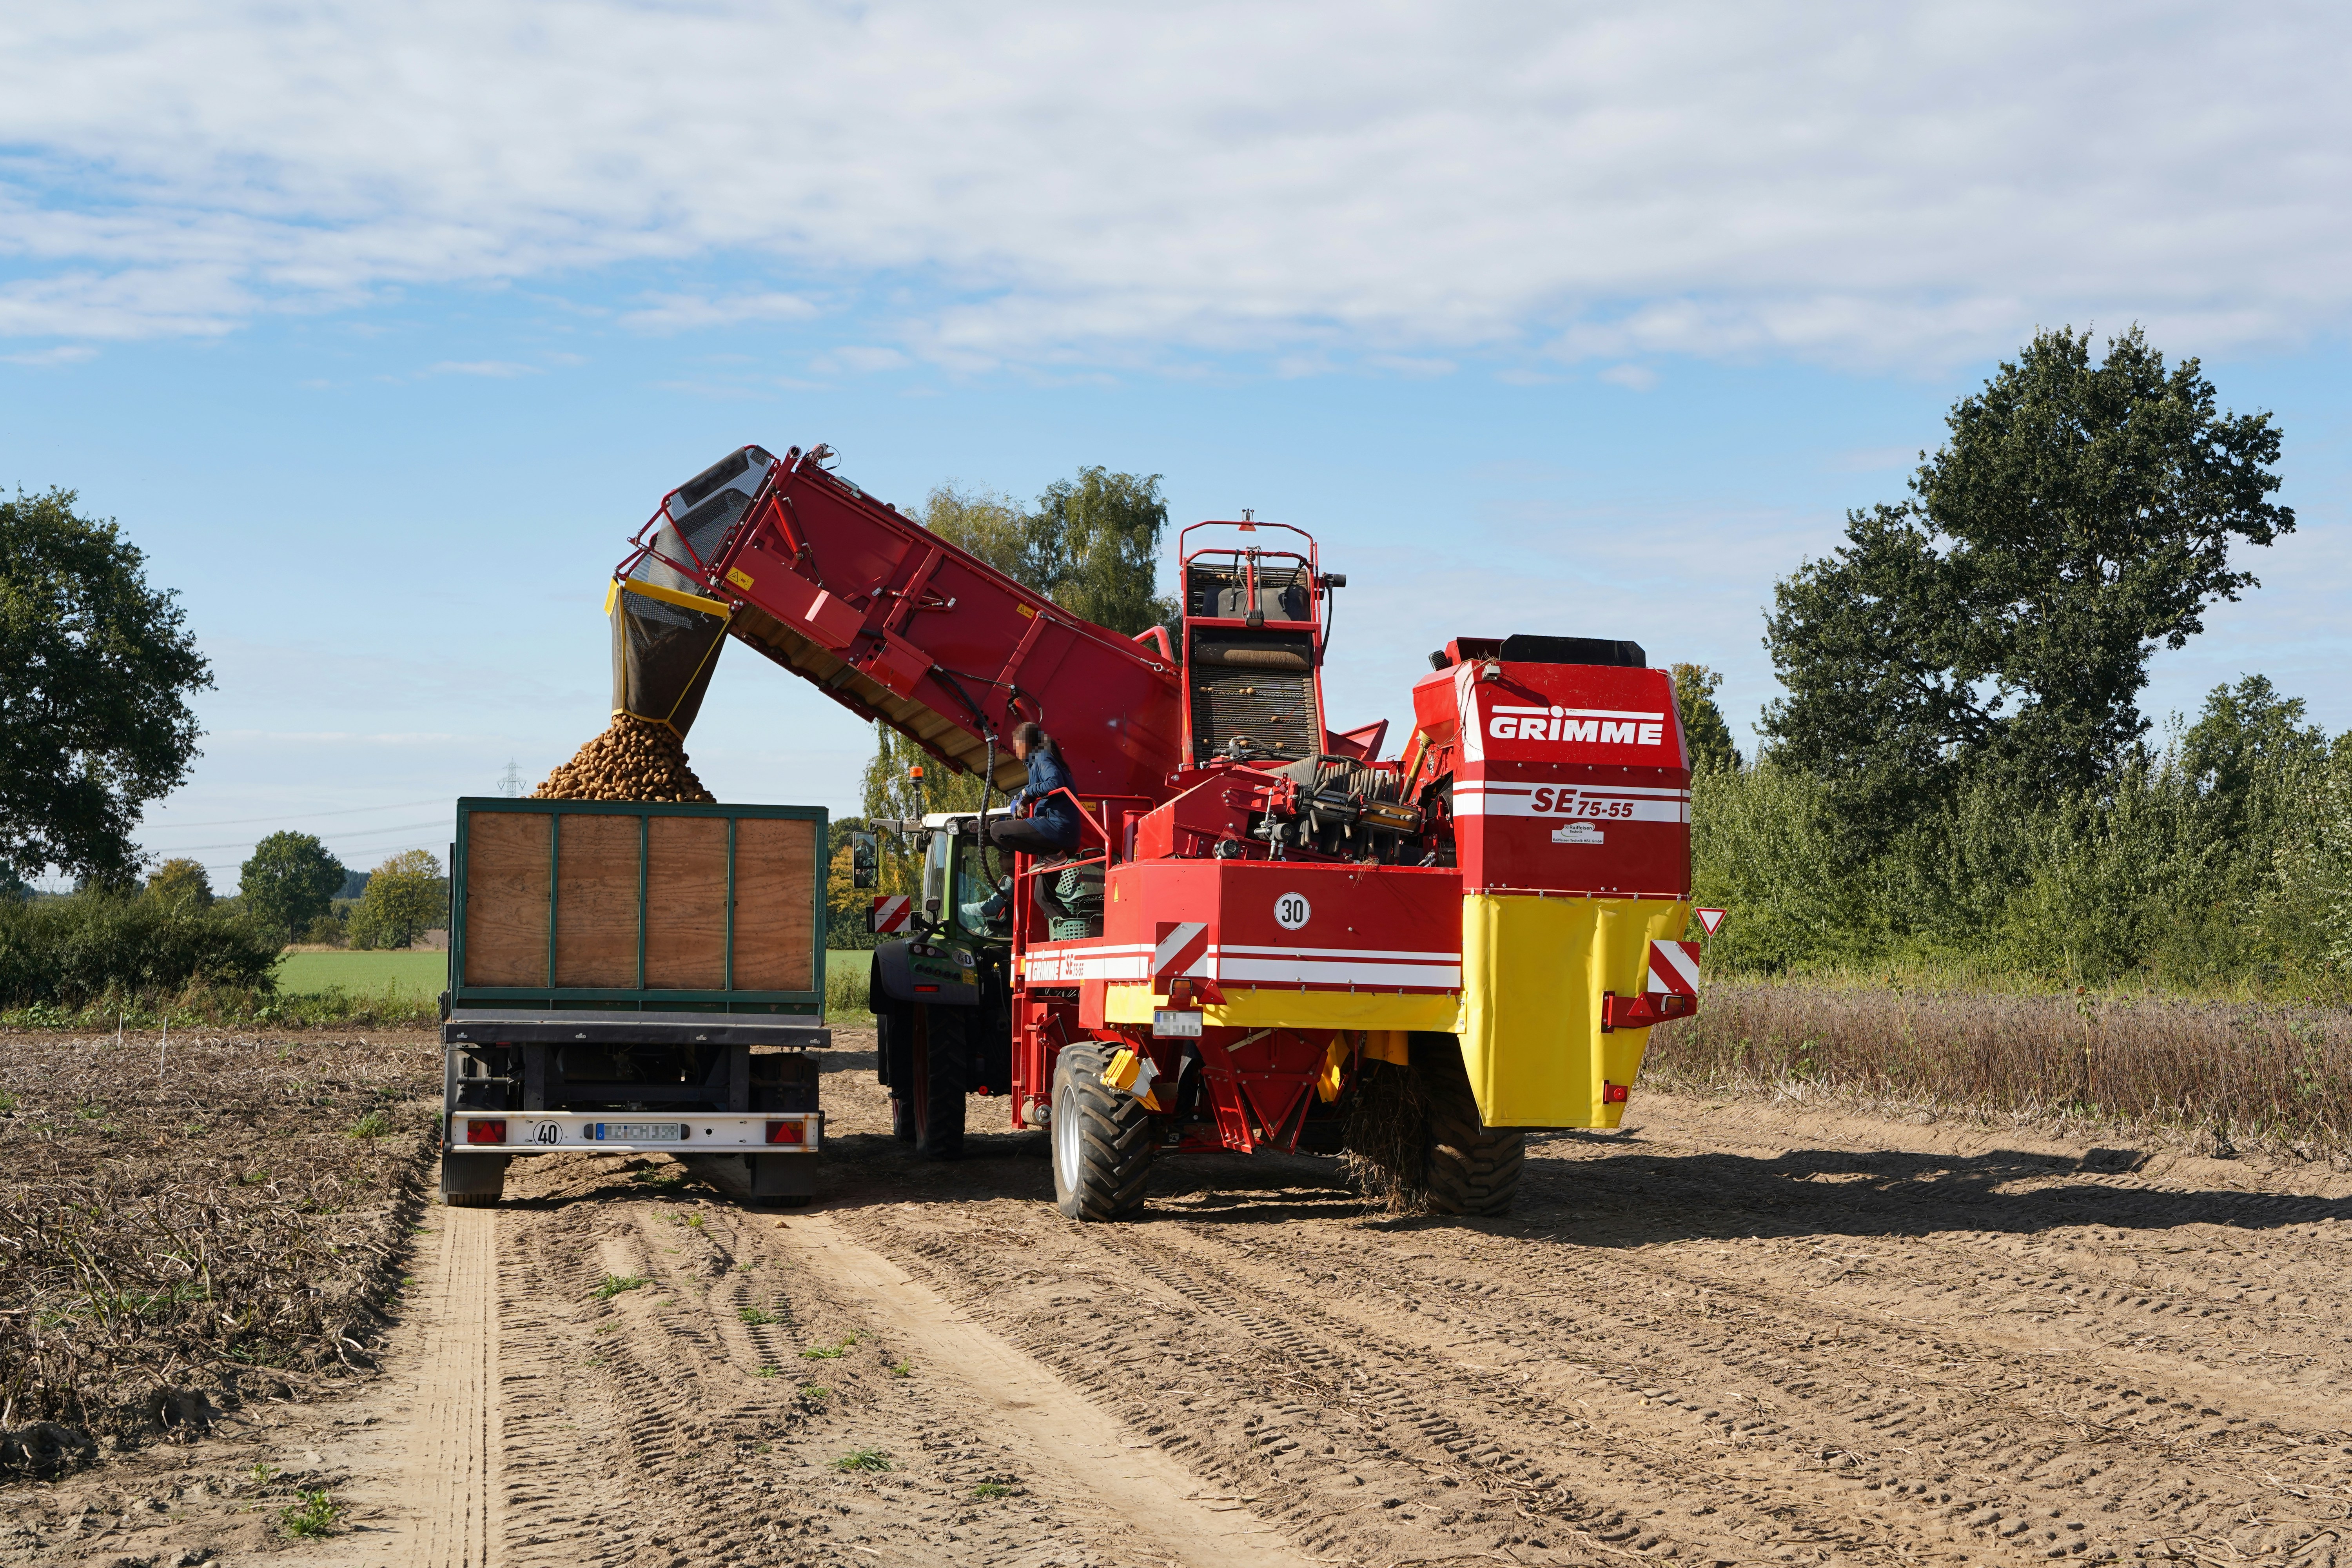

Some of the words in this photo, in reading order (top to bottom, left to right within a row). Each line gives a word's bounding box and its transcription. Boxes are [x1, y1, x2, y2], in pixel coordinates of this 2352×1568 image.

[1489, 706, 1663, 745] GRIMME
[1531, 788, 1577, 813] SE
[1577, 801, 1634, 818] 75-55
[1282, 899, 1303, 923] 30
[1032, 949, 1060, 981] GRIMME
[1065, 954, 1074, 975] SE
[1073, 963, 1084, 977] 75-55
[538, 1124, 557, 1144] 40
